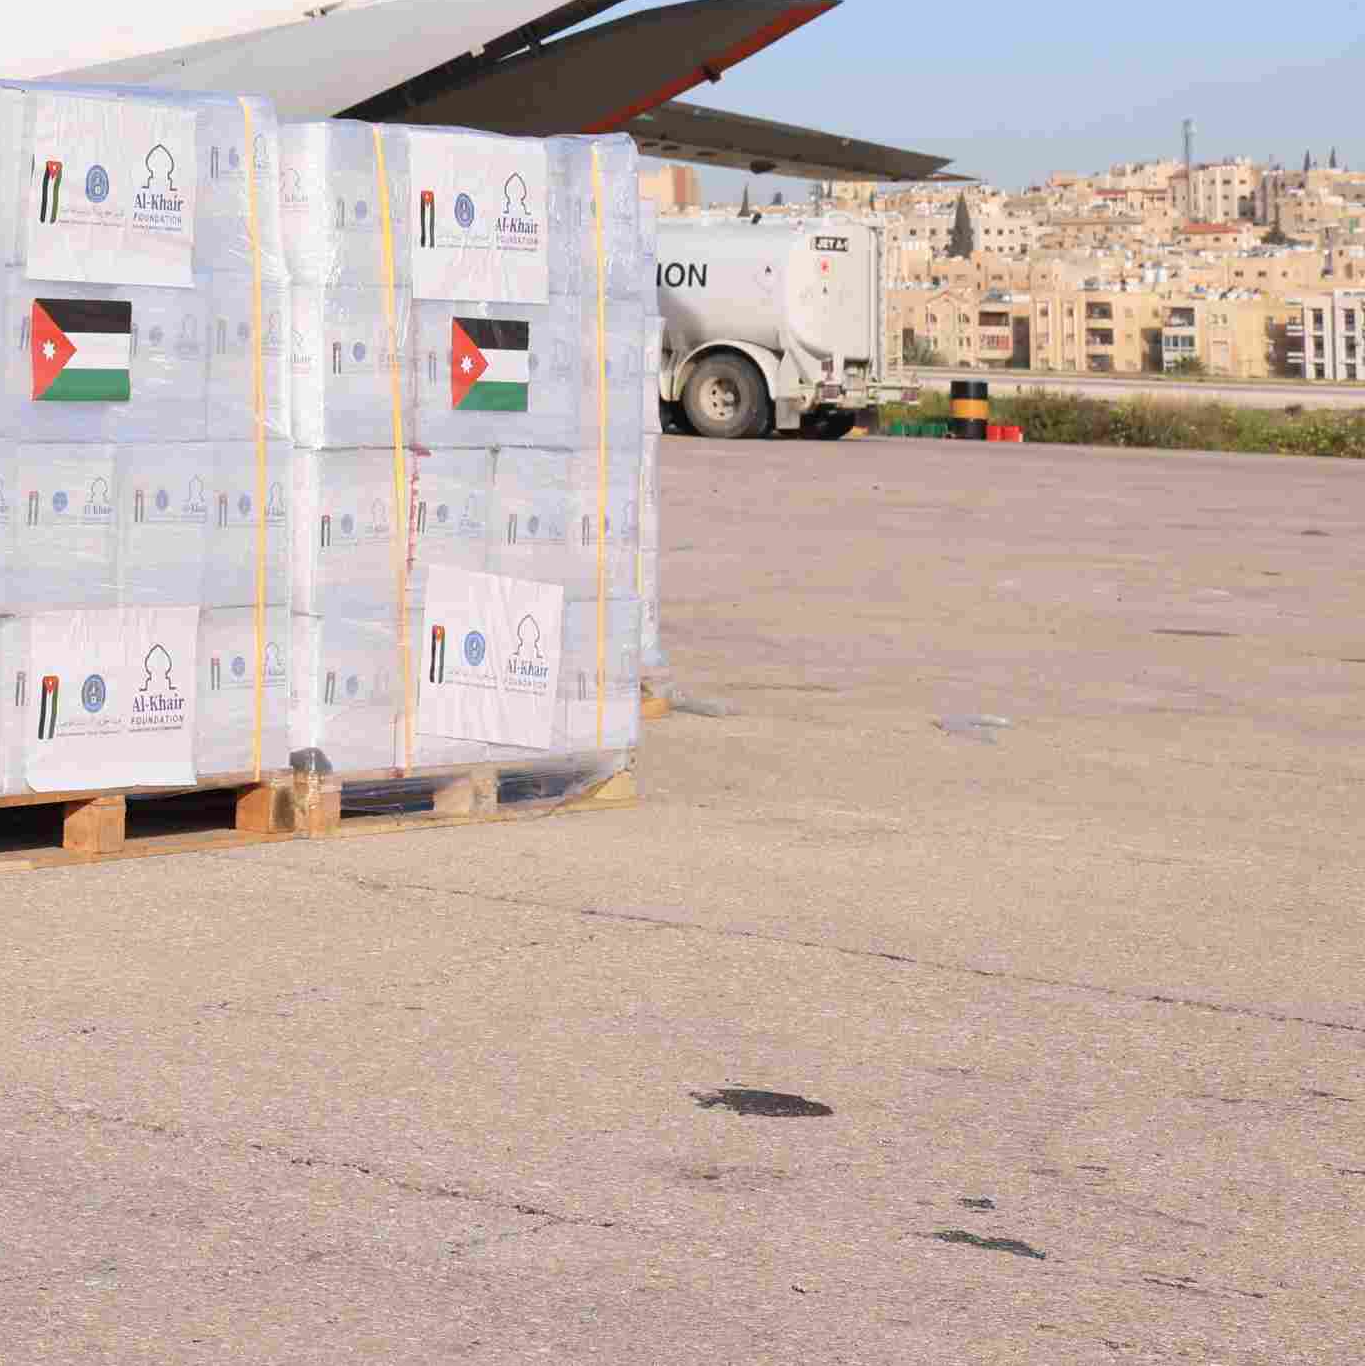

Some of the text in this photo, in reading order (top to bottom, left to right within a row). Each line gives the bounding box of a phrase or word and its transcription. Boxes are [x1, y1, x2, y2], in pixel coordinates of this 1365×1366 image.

[134, 194, 183, 211] Al-Khair
[494, 217, 538, 234] Al-Khair
[656, 263, 707, 287] ION
[506, 658, 548, 678] Al-Khair
[133, 693, 184, 713] Al-Khair
[131, 714, 184, 725] FOUNDATION
